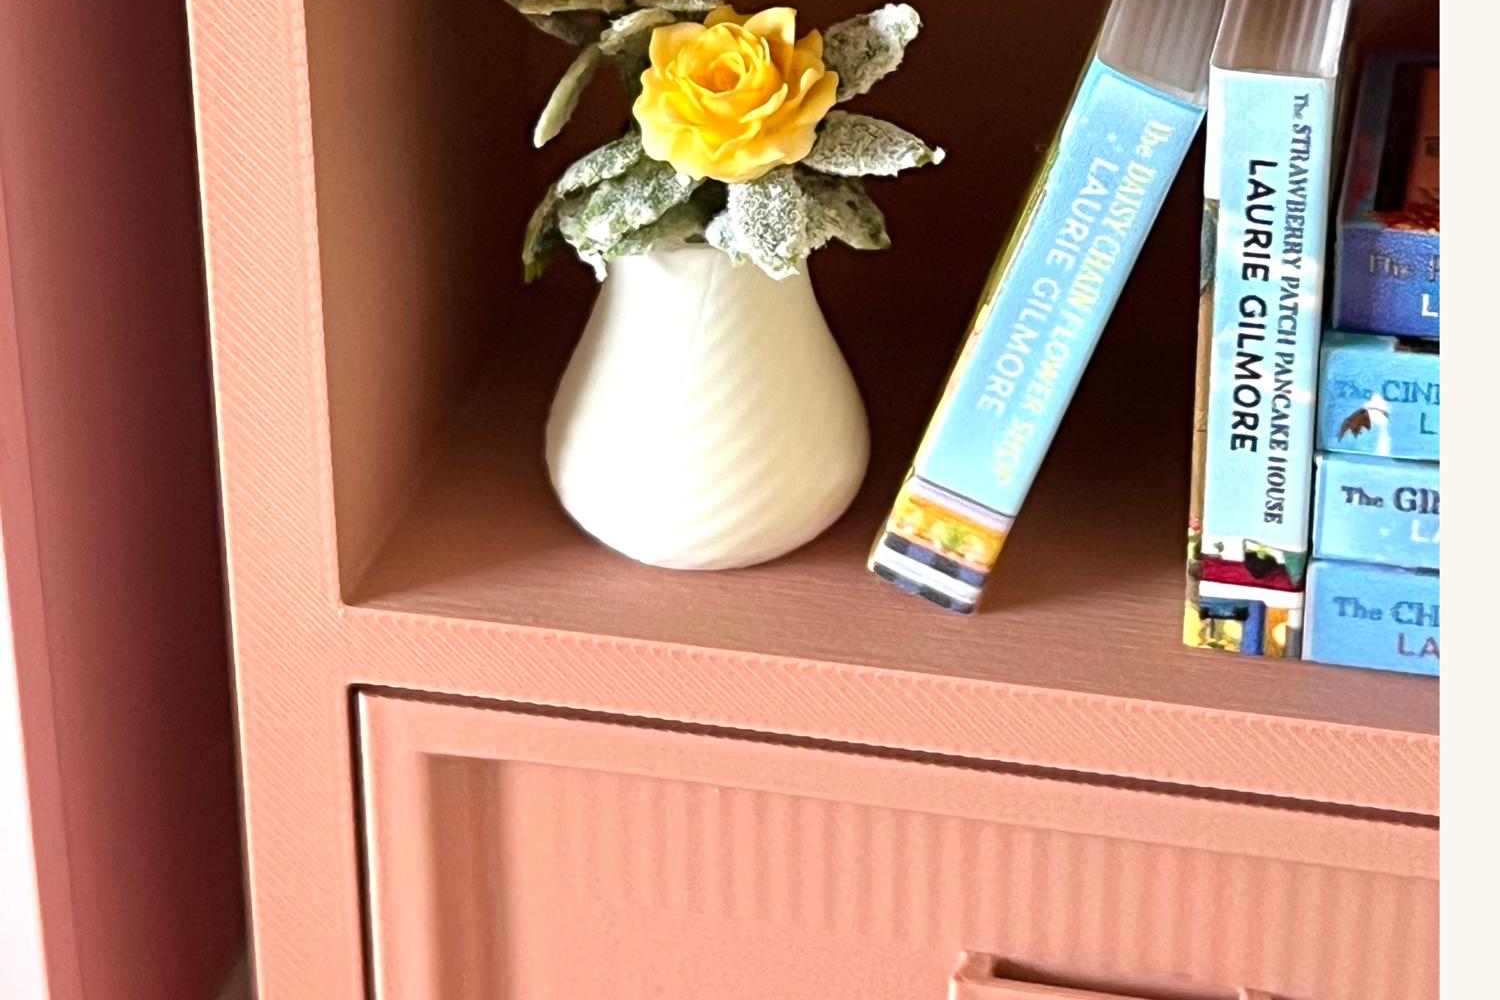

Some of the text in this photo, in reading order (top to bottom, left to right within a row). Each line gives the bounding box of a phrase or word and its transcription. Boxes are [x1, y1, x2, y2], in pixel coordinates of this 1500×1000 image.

[1101, 160, 1157, 237] DAISY
[976, 157, 1120, 416] LAURIE GILMORE
[1066, 235, 1120, 312] CHAIN
[1230, 159, 1278, 452] LAURIE GILMORE
[1263, 93, 1312, 524] The STRAWBERRY PATCH PANCAKE HOUSE
[1018, 311, 1084, 415] FLOWER
[1341, 485, 1384, 508] The
[1333, 596, 1382, 621] The
